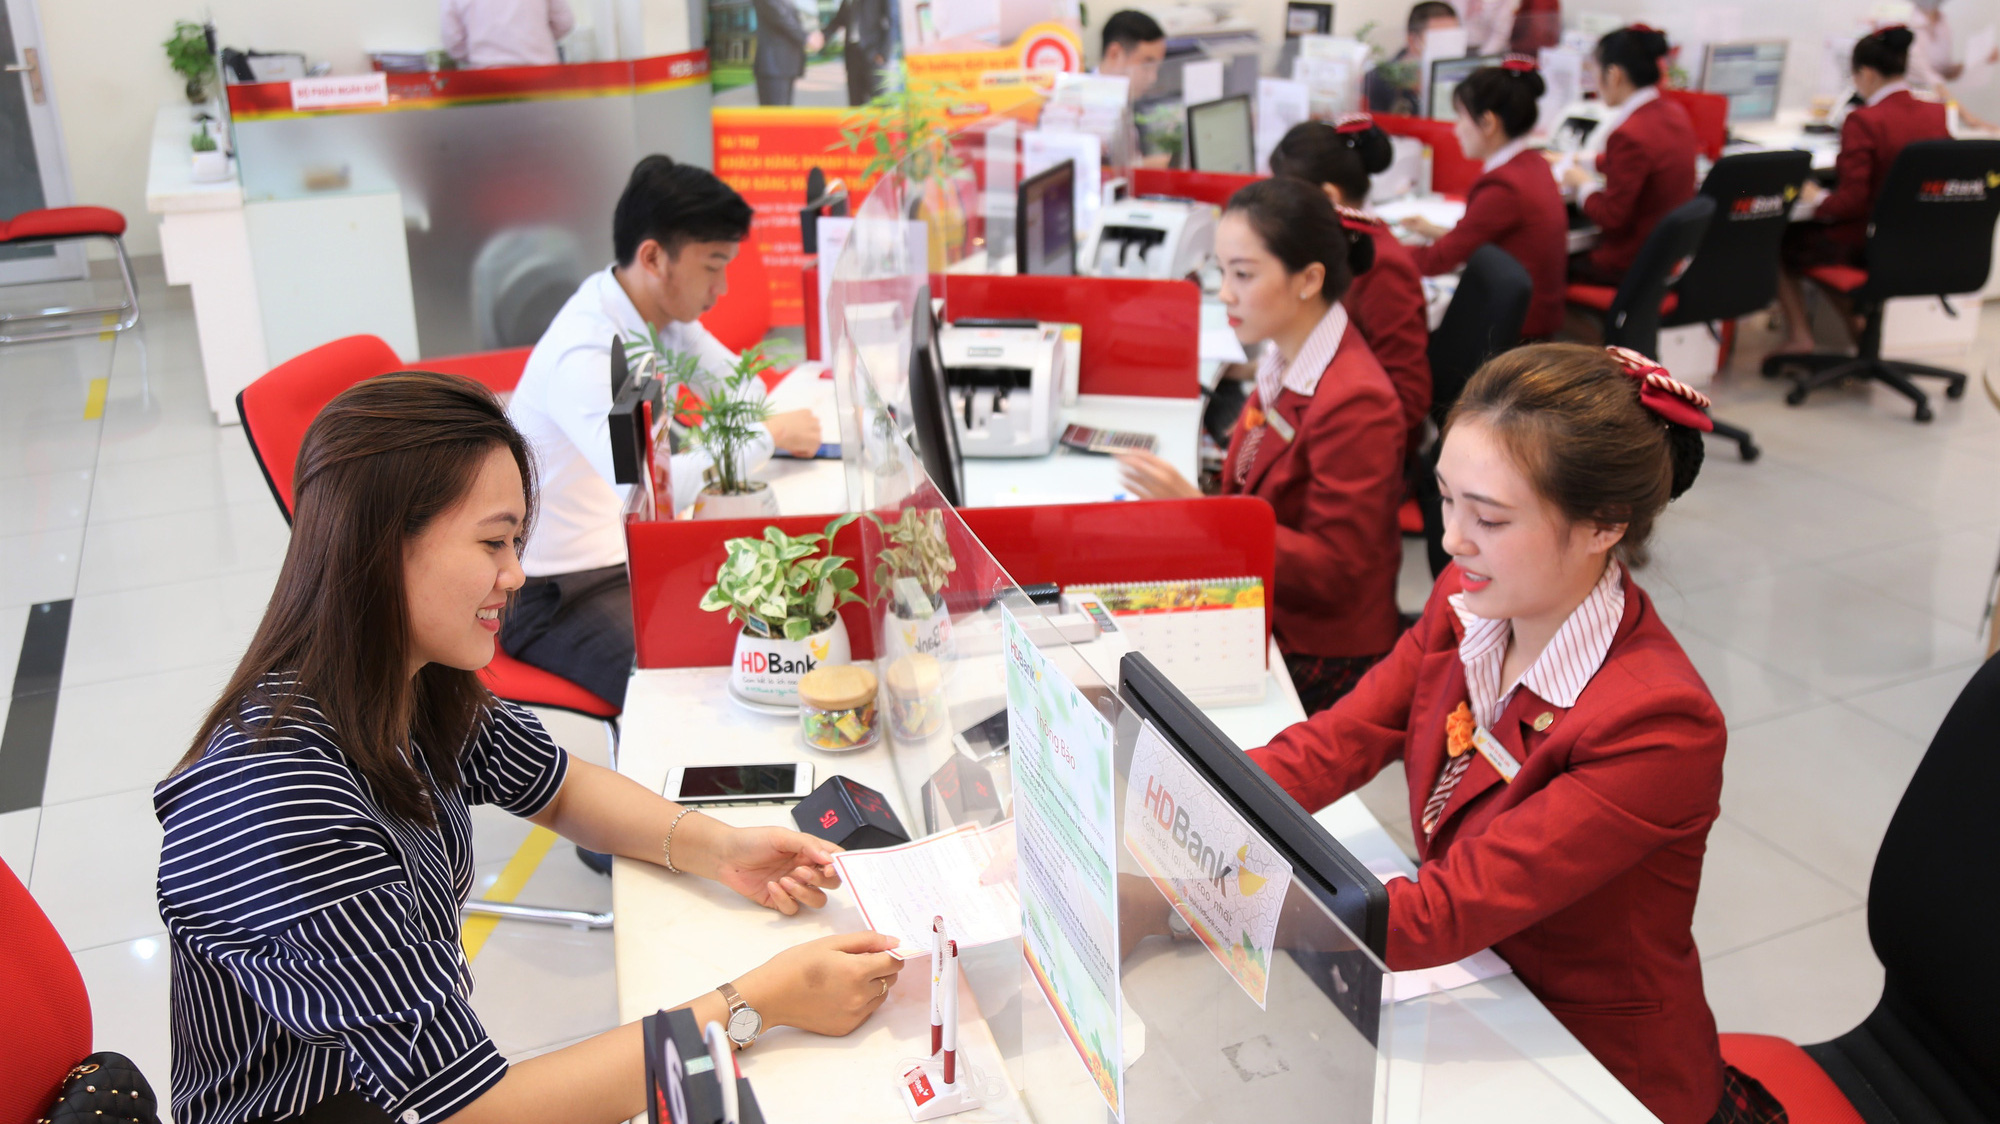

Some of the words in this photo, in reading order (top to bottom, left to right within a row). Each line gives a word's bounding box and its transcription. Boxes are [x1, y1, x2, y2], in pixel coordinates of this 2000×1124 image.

[741, 651, 817, 674] HDBank
[1035, 705, 1060, 754] Thông
[1060, 738, 1076, 770] Báo
[1144, 774, 1232, 898] HDBank
[1196, 881, 1211, 902] cao
[1213, 901, 1233, 927] nhất
